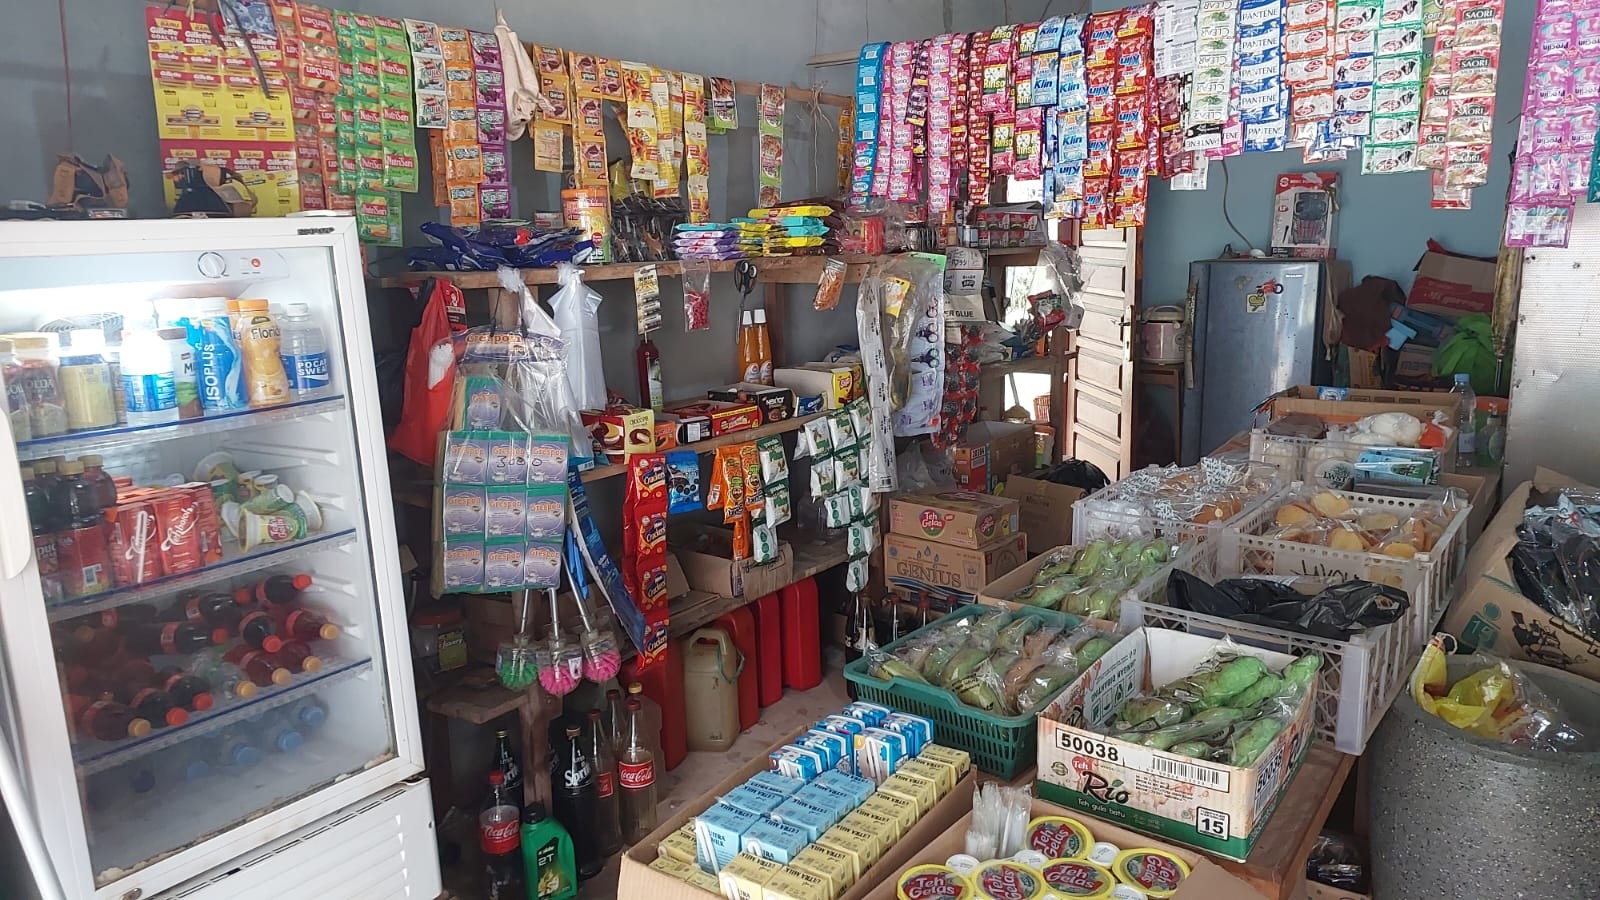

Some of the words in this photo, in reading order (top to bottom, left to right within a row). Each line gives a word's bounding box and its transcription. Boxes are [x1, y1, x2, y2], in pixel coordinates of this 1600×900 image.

[1204, 1, 1232, 10] CLEAR
[1243, 9, 1277, 20] PANTENE
[1466, 10, 1492, 19] SAORI
[150, 26, 178, 36] Gillette
[185, 30, 212, 40] Gillette
[991, 31, 1011, 40] Rinso
[1040, 26, 1058, 36] Klin
[1091, 28, 1113, 39] Klin
[1202, 28, 1229, 37] CLEAR
[1243, 38, 1277, 48] PANTENE
[1120, 54, 1139, 65] Klin
[1199, 56, 1226, 65] CLEAR
[1462, 59, 1488, 68] SAORI
[1242, 67, 1277, 76] PANTENE
[984, 79, 1006, 89] Rinso
[1034, 80, 1052, 89] Klin
[1060, 82, 1080, 93] Klin
[1089, 86, 1109, 95] Klin
[1242, 96, 1276, 105] PANTENE
[1118, 111, 1139, 121] Klin
[994, 138, 1013, 147] Rinso
[1062, 135, 1083, 146] Klin
[1016, 145, 1039, 154] Rinso
[1059, 164, 1080, 176] Klin
[1119, 166, 1140, 177] Klin
[202, 343, 221, 400] ISOPLUS
[298, 367, 326, 376] SWEA
[924, 512, 937, 520] Teh
[922, 519, 943, 528] Gelas
[897, 562, 961, 588] GENIUS
[1061, 733, 1119, 762] 50038
[1073, 761, 1089, 770] Teh
[620, 768, 654, 782] Coca-Cola
[1082, 771, 1130, 804] Rio
[1078, 799, 1090, 807] Teh
[1091, 803, 1107, 812] gula
[1109, 808, 1126, 818] batu
[1201, 818, 1224, 834] 15
[1034, 830, 1054, 848] Teh
[1044, 829, 1068, 857] Gelas
[538, 853, 554, 866] 2T
[1060, 866, 1087, 878] Teh
[1142, 856, 1162, 882] Gelas
[1158, 865, 1176, 883] Teh
[917, 876, 943, 887] Teh
[988, 873, 1002, 895] Teh
[1005, 869, 1022, 900] Gelas
[1046, 872, 1095, 888] Gelas
[909, 885, 955, 898] Gelas
